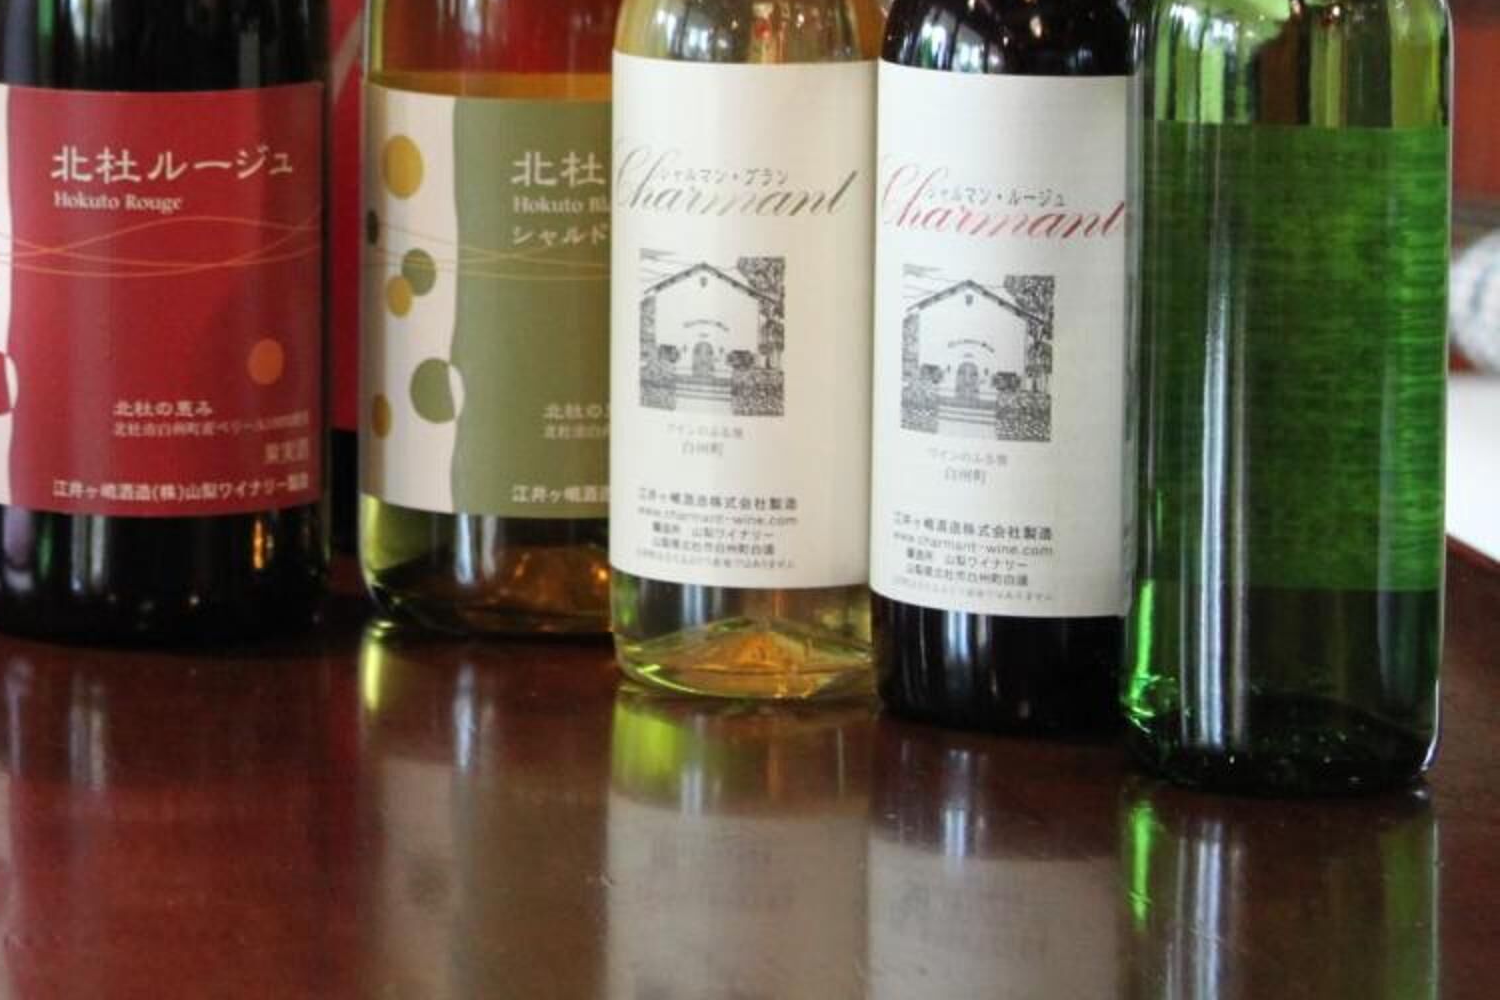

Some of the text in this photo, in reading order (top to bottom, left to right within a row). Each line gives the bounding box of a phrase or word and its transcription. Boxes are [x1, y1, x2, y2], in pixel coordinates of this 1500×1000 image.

[51, 144, 293, 184] 北杜ルージュ
[511, 150, 607, 187] 北杜
[615, 145, 858, 217] Charmant
[53, 190, 183, 214] Hokuto Rouge
[513, 195, 584, 214] Hokuto
[881, 160, 1126, 239] Charmant
[513, 222, 609, 247] シャルド
[113, 400, 214, 418] 北杜の恵み
[543, 401, 611, 420] 北杜の
